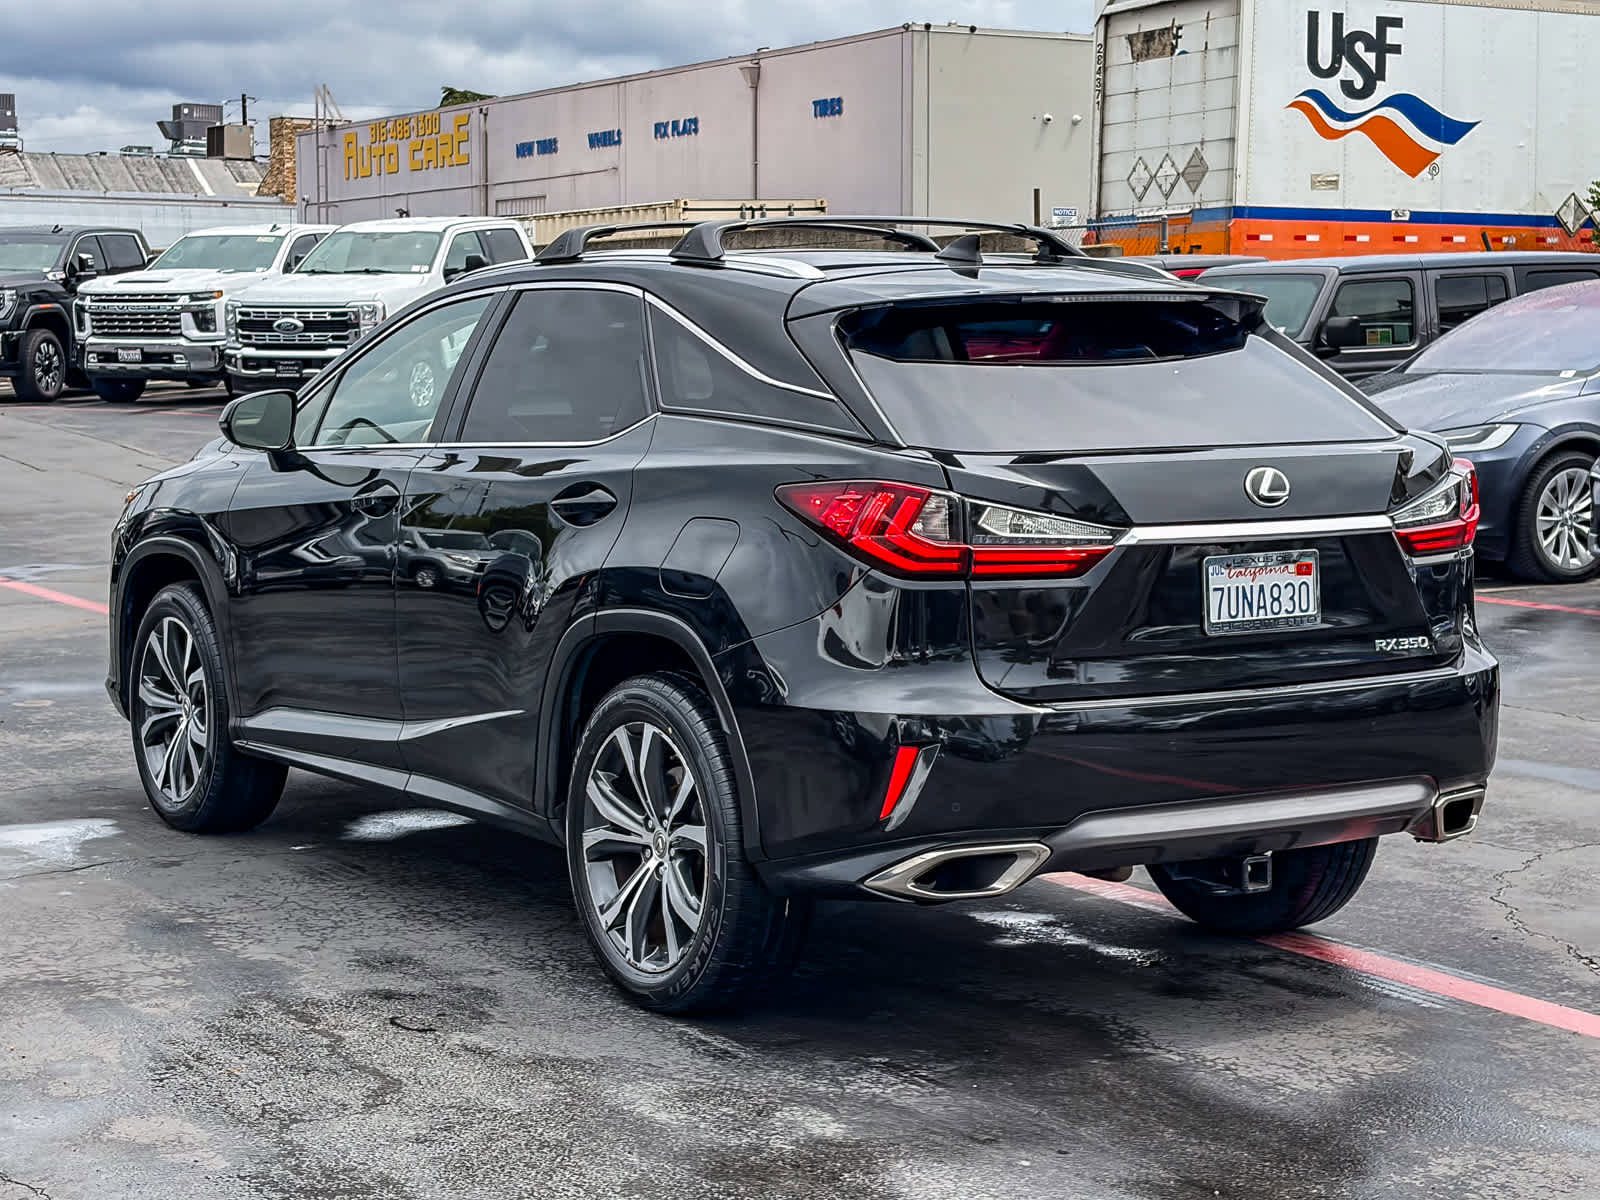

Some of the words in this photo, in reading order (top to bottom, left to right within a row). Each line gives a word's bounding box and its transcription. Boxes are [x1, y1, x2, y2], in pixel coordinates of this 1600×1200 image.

[1307, 10, 1404, 101] USF
[812, 96, 844, 118] TIRES
[672, 116, 699, 137] FLATS
[587, 128, 622, 150] WHEELS
[1054, 208, 1077, 216] NOTICE
[1232, 555, 1274, 565] LEXUS
[1210, 565, 1225, 577] JUL
[1226, 565, 1296, 583] California
[1212, 580, 1311, 621] 7UNA830
[1374, 636, 1429, 652] RX350
